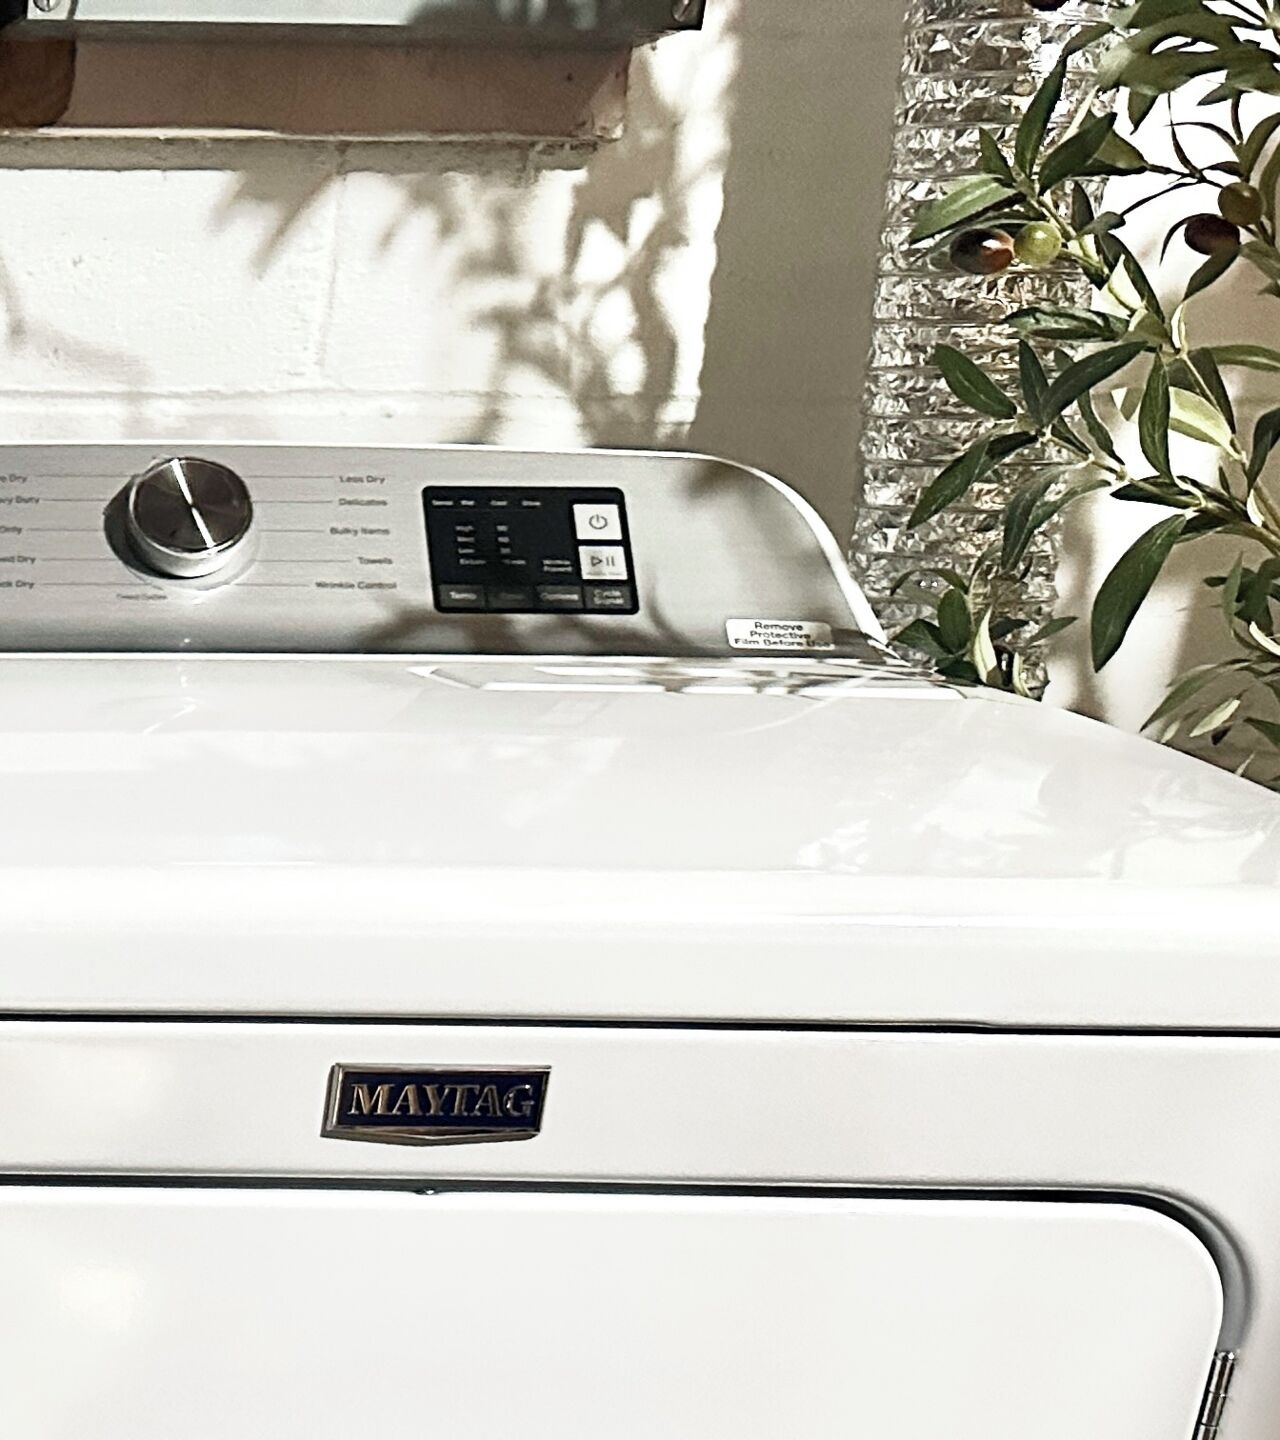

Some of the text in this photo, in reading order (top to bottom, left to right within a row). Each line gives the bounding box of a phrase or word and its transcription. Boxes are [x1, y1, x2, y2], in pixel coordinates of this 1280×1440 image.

[9, 475, 28, 484] Dry
[366, 475, 385, 485] Dry
[0, 525, 23, 535] Only
[17, 555, 37, 565] Dry
[16, 580, 35, 590] Dry
[754, 621, 803, 631] Remove
[749, 631, 811, 640] Protective
[763, 639, 803, 647] Before
[806, 640, 831, 648] Use
[347, 1083, 535, 1117] MAYTAG
